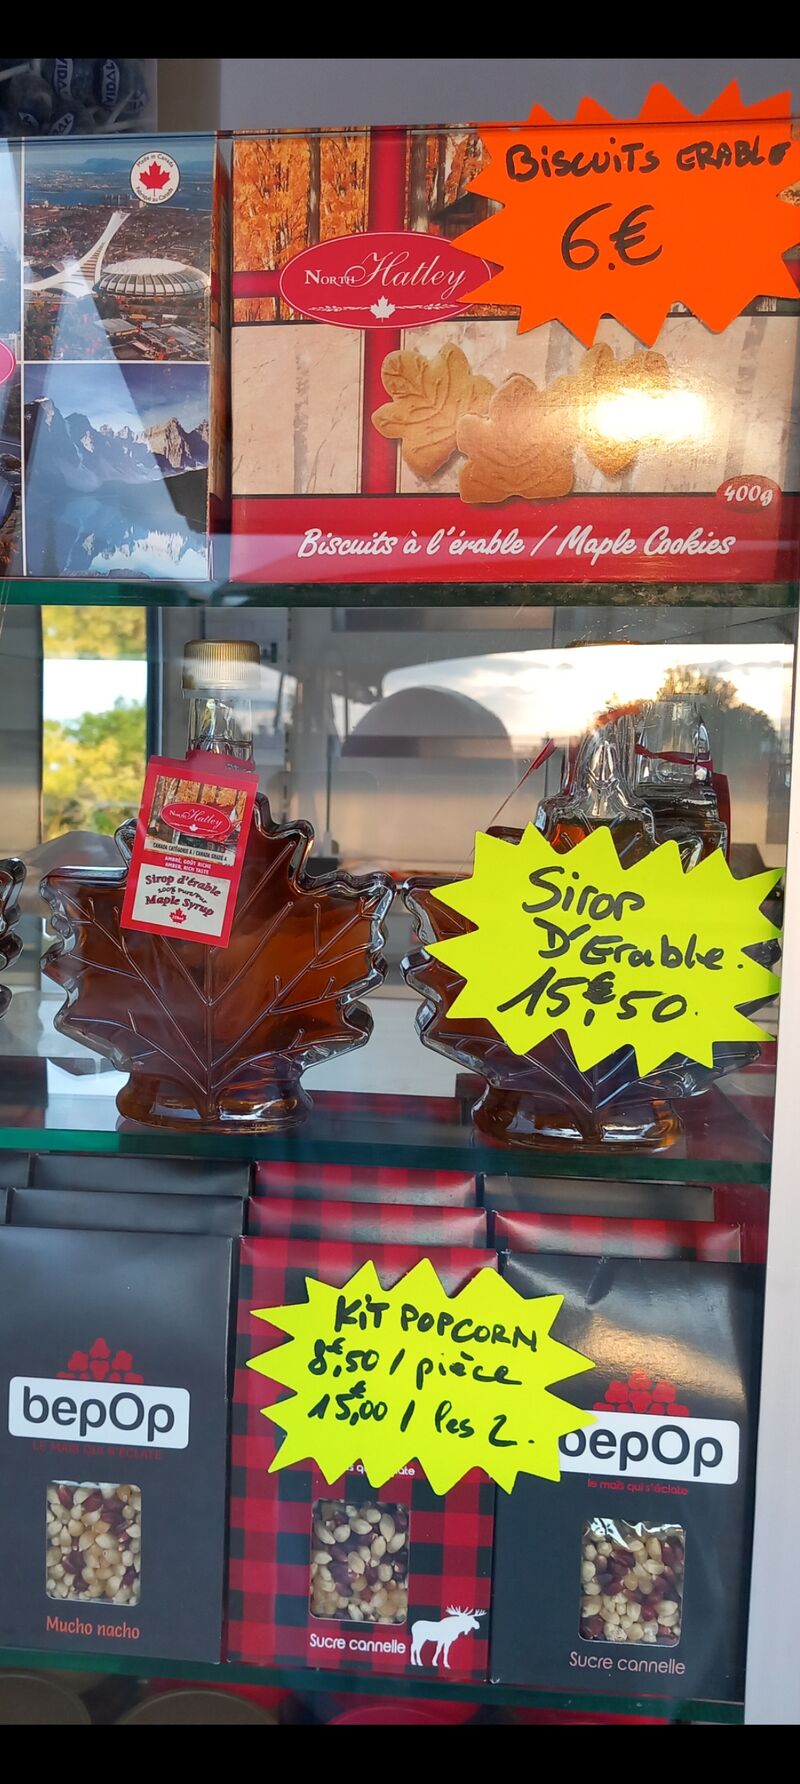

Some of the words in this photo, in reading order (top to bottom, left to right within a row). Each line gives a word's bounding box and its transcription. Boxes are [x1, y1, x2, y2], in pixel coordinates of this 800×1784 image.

[344, 251, 466, 300] Hatley
[723, 484, 774, 507] 400g
[297, 528, 398, 558] Biscuits
[402, 530, 421, 554] à
[426, 527, 525, 555] l'érable
[530, 525, 557, 557] /
[556, 525, 637, 566] Maple
[643, 525, 736, 556] Cookies
[182, 808, 223, 830] Hatley
[145, 874, 175, 886] Sirop
[177, 875, 221, 897] d'érable
[145, 894, 180, 907] Maple
[182, 898, 214, 917] Syrup
[400, 1303, 537, 1352] POPCORN
[416, 1352, 522, 1390] pièce
[23, 1385, 175, 1442] bepOp
[434, 1399, 475, 1438] les
[46, 1616, 93, 1636] Mucho
[97, 1621, 140, 1640] nacho
[309, 1633, 346, 1650] Sucre
[348, 1637, 407, 1654] cannelle
[569, 1651, 612, 1670] Sucre
[617, 1656, 686, 1676] cannelle
